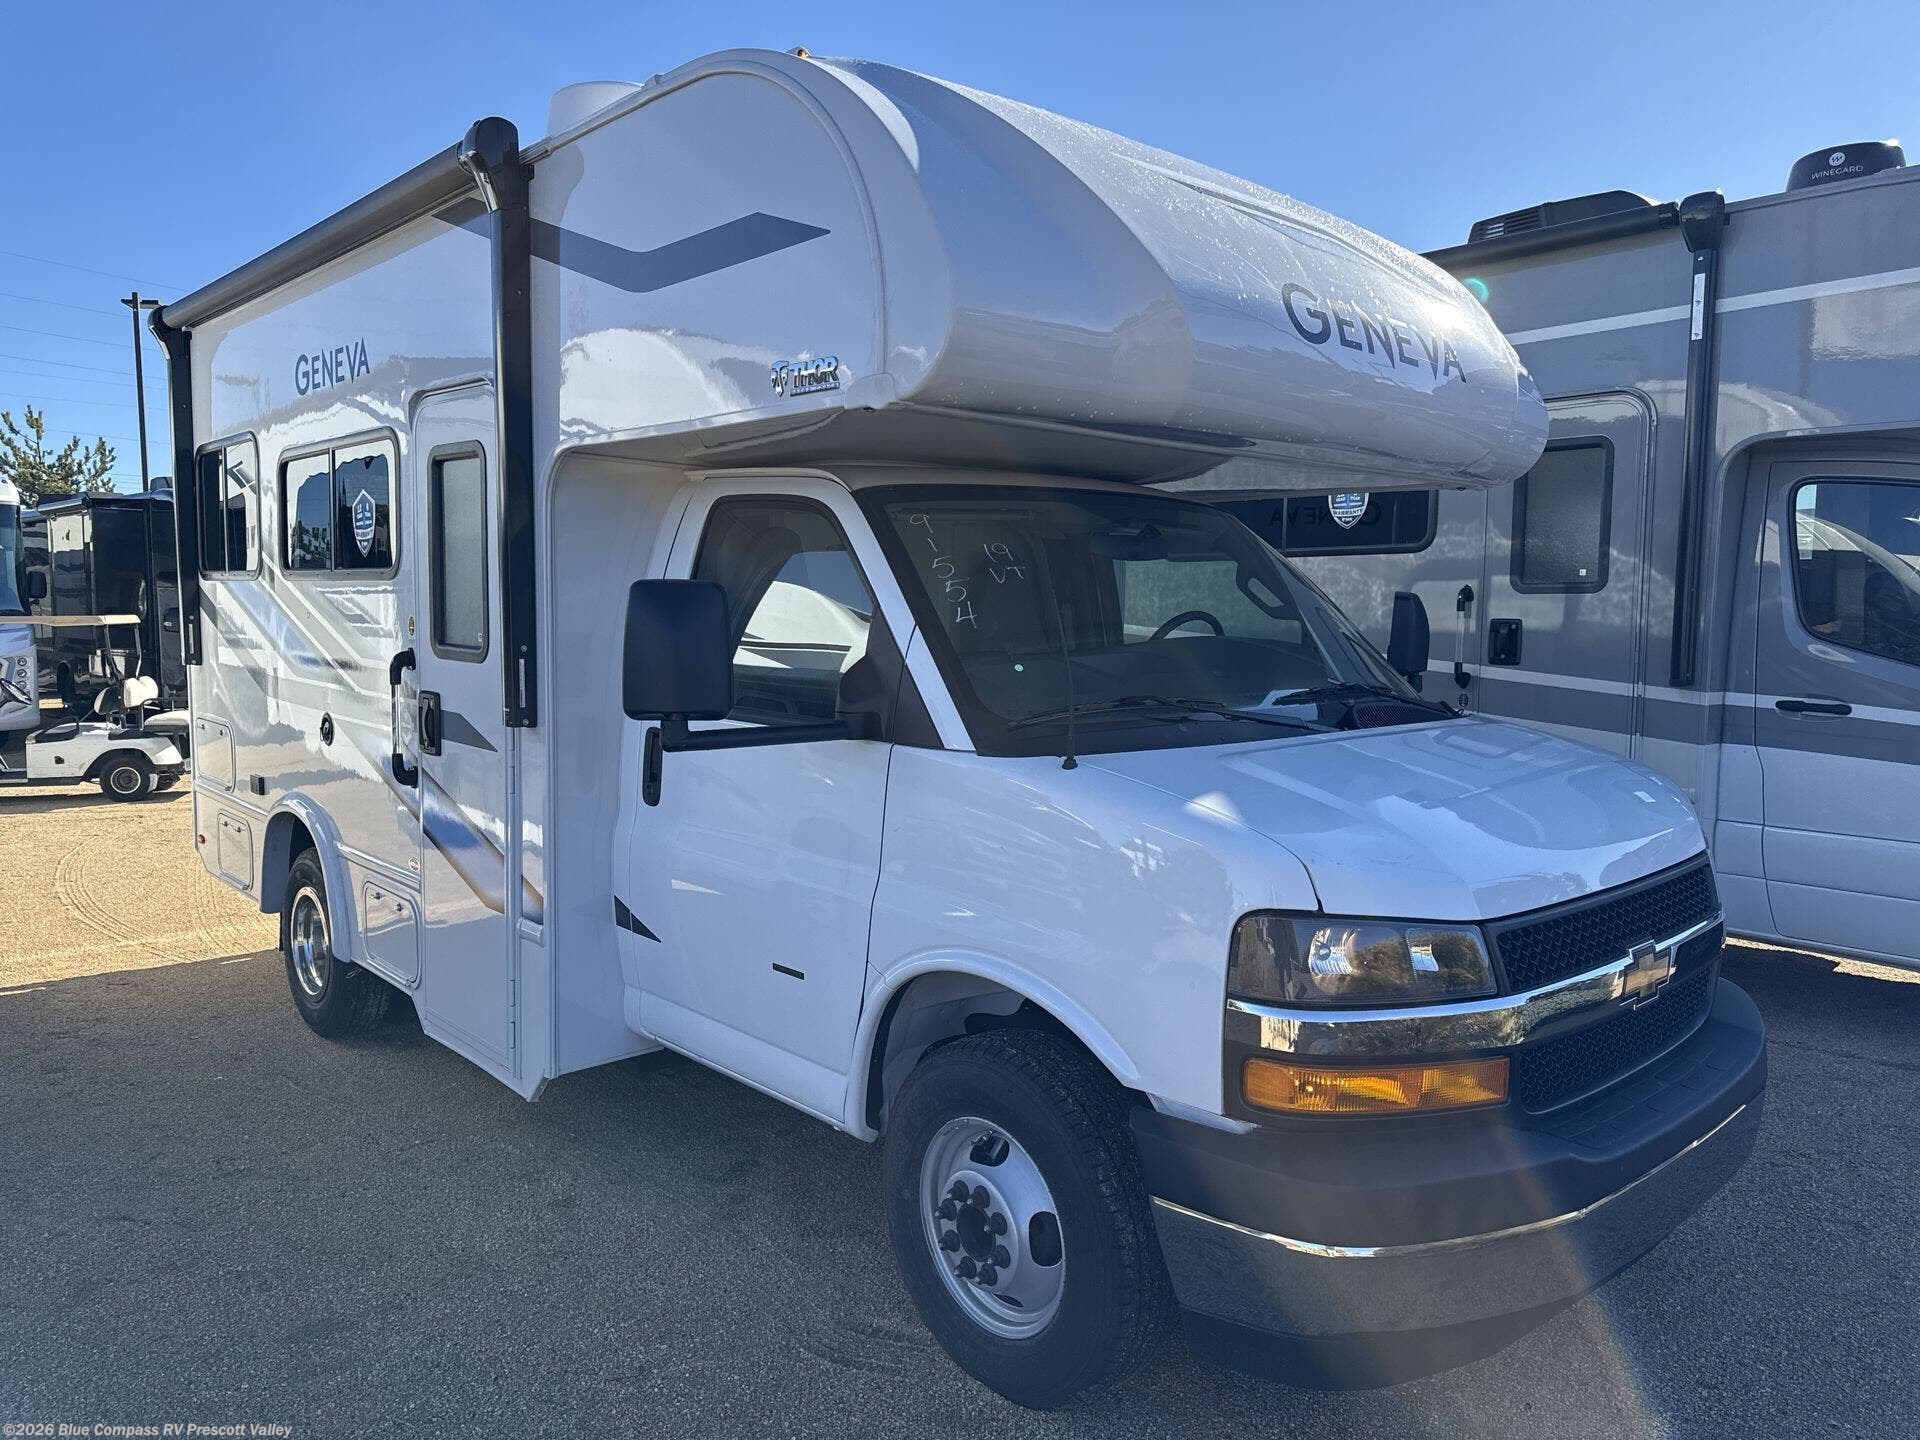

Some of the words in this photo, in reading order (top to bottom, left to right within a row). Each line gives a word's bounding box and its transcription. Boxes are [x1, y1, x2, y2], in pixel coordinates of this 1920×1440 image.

[1811, 165, 1864, 180] WINEGARD
[1281, 282, 1467, 384] GENEVA
[295, 336, 370, 396] GENEVA
[789, 356, 840, 388] THOR
